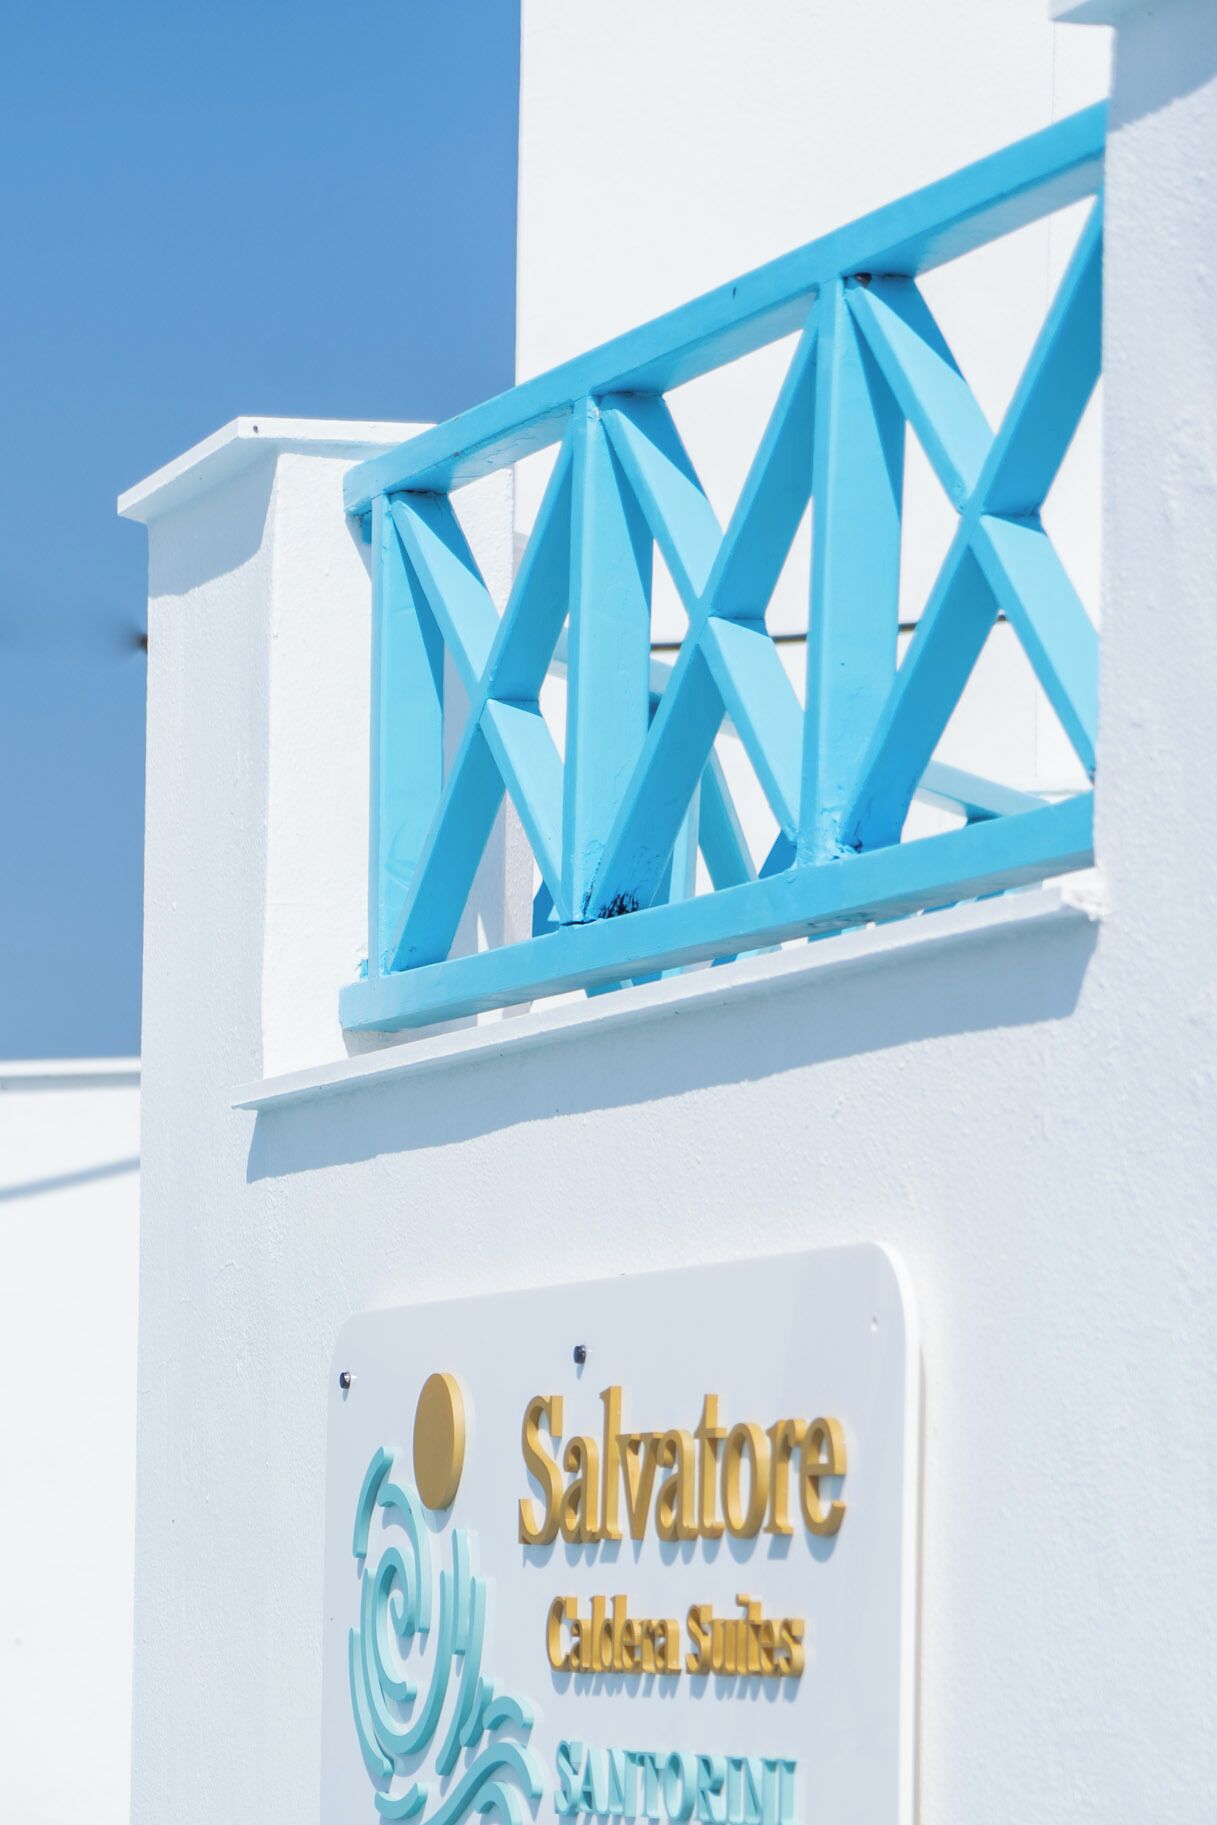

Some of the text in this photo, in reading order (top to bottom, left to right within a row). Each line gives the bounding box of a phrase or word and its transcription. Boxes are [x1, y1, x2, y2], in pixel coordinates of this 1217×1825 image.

[519, 1386, 847, 1545] Salvatore
[546, 1593, 805, 1678] Caldera Suites
